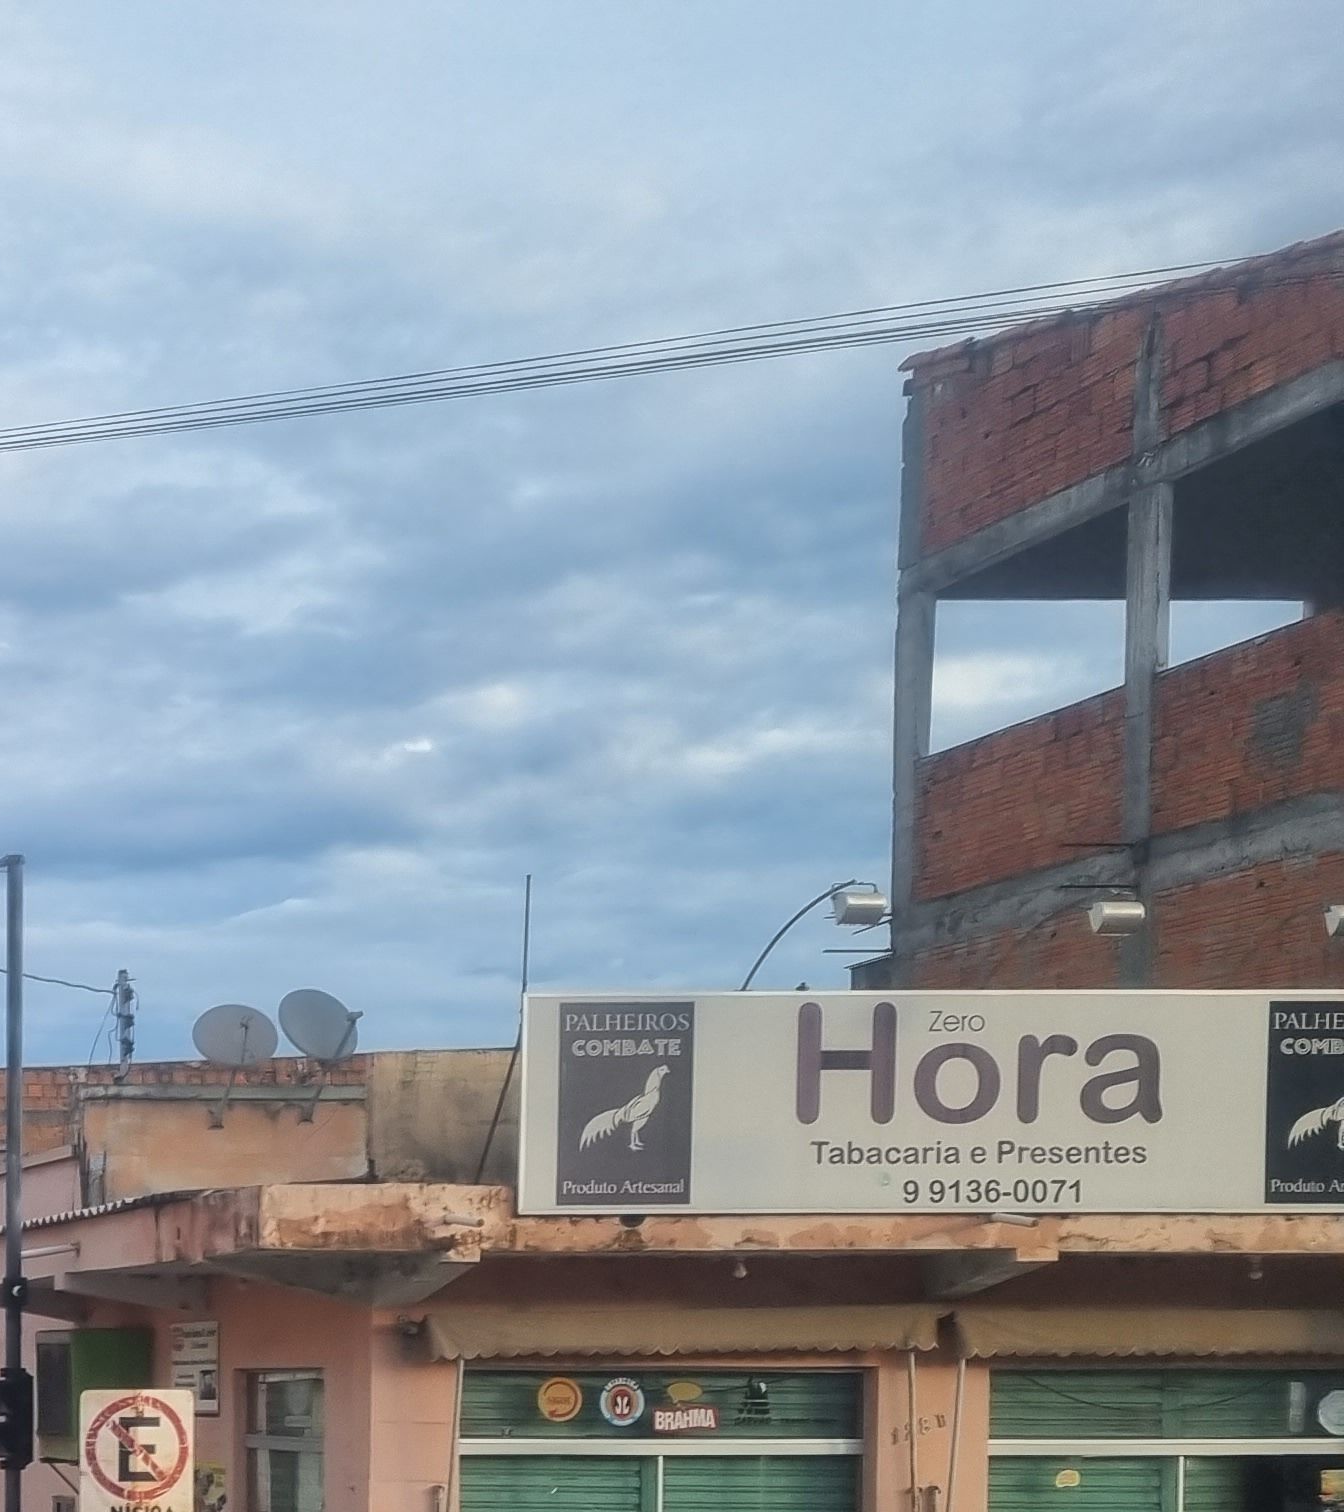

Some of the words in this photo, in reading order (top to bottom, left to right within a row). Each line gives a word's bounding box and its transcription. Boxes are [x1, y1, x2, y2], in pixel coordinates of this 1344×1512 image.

[565, 1013, 690, 1032] PALHEIROS
[928, 1011, 986, 1032] Zero
[1273, 1012, 1344, 1030] PALHE
[572, 1039, 681, 1057] COMBATE
[796, 1002, 1163, 1124] Hora
[810, 1141, 960, 1165] Tabacaria
[971, 1147, 987, 1164] e
[997, 1141, 1148, 1164] Presentes
[563, 1180, 617, 1195] Produto
[620, 1179, 684, 1194] Artesanal
[903, 1180, 919, 1203] 9
[928, 1179, 1082, 1203] 9136-0071
[1270, 1178, 1325, 1193] Produto
[654, 1408, 716, 1431] BRAHMA
